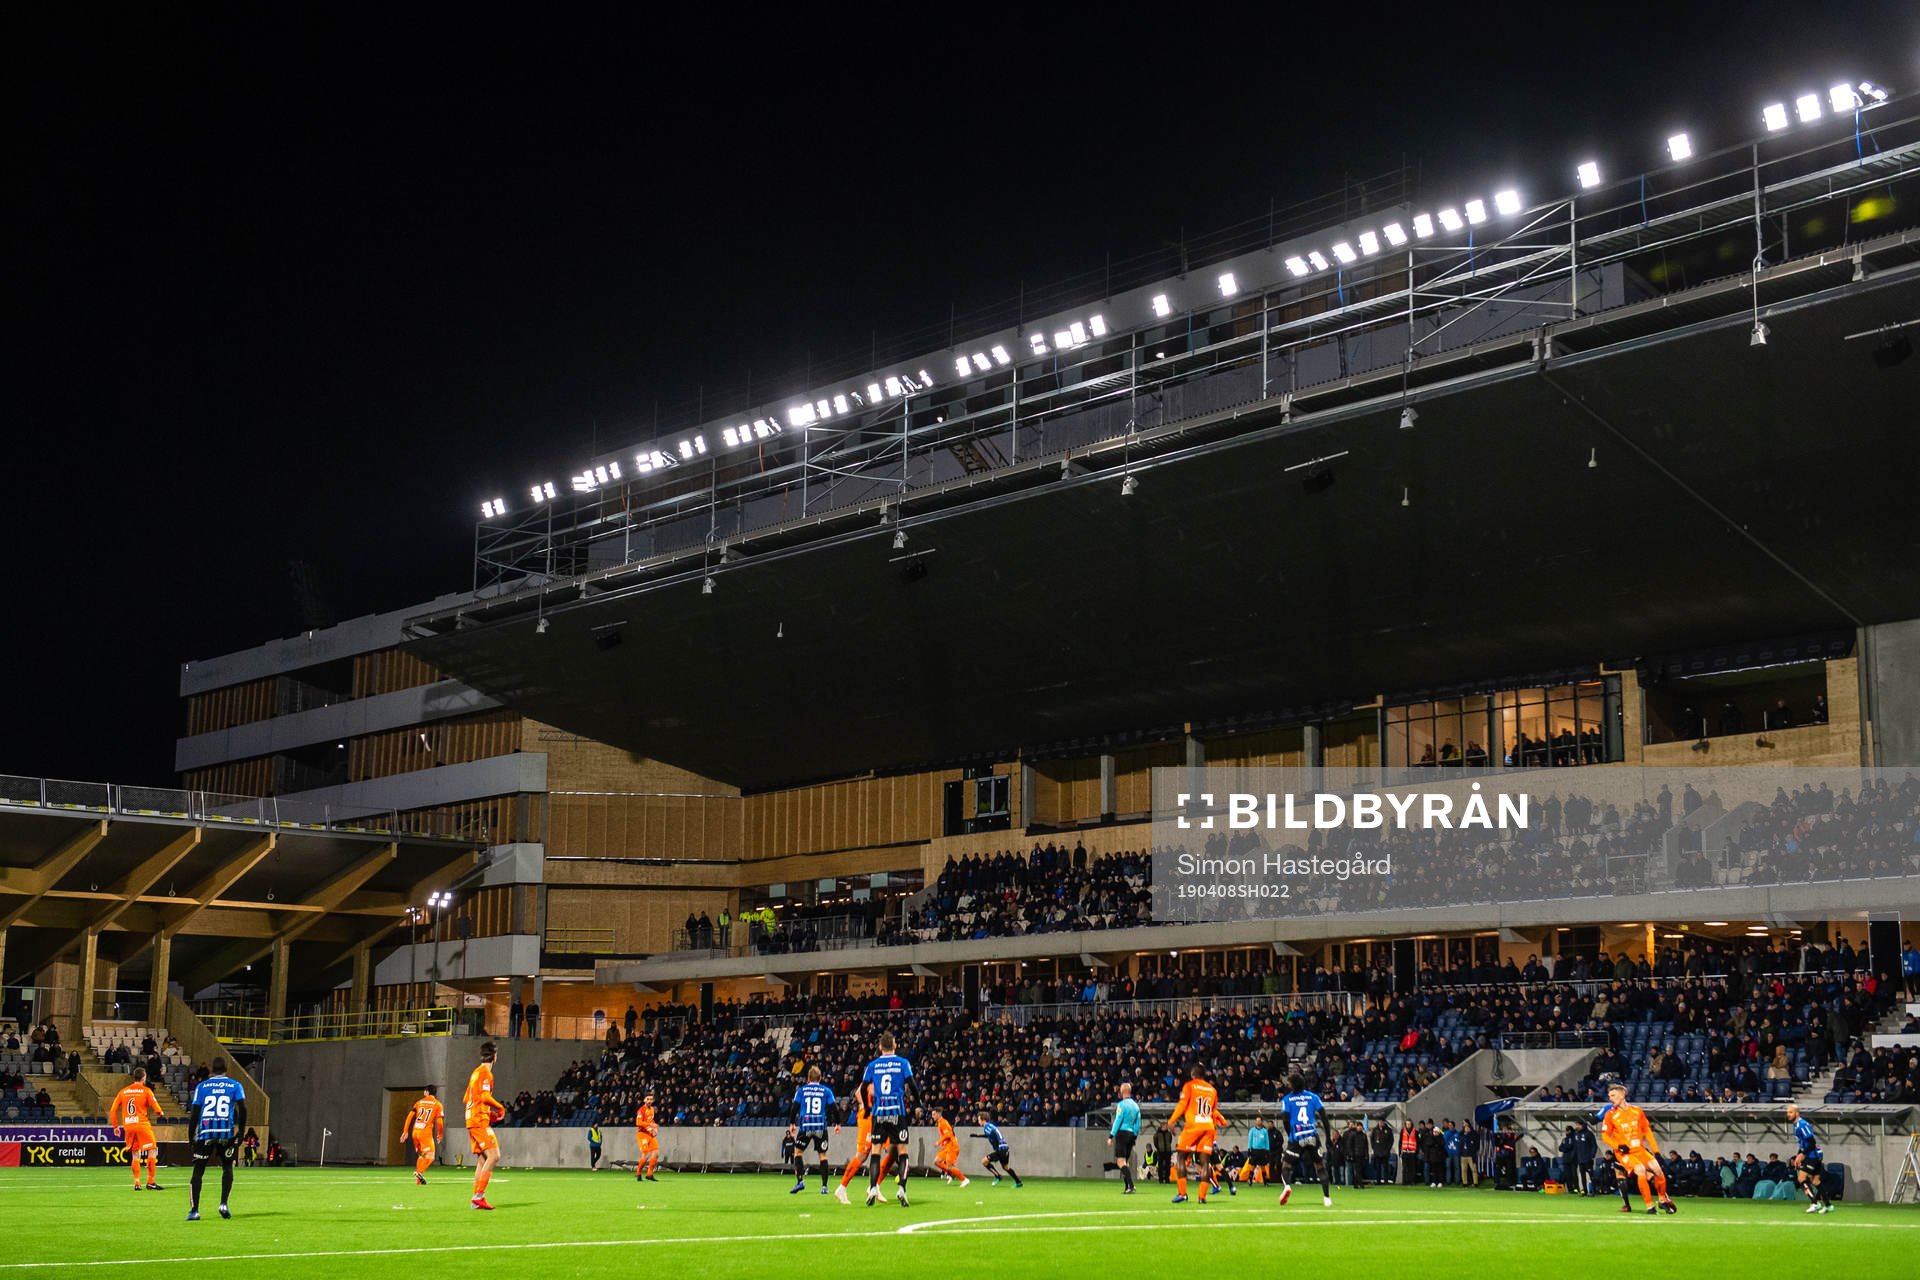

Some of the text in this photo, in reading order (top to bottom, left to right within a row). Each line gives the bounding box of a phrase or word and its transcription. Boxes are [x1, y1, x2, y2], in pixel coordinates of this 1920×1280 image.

[881, 1074, 892, 1095] 6
[127, 1097, 137, 1116] 6
[202, 1095, 231, 1117] 26
[416, 1106, 432, 1122] 21
[805, 1096, 822, 1114] 19
[1195, 1095, 1212, 1116] 16
[1297, 1106, 1309, 1124] 4
[27, 1146, 86, 1164] YRC rental
[102, 1146, 128, 1164] YRC
